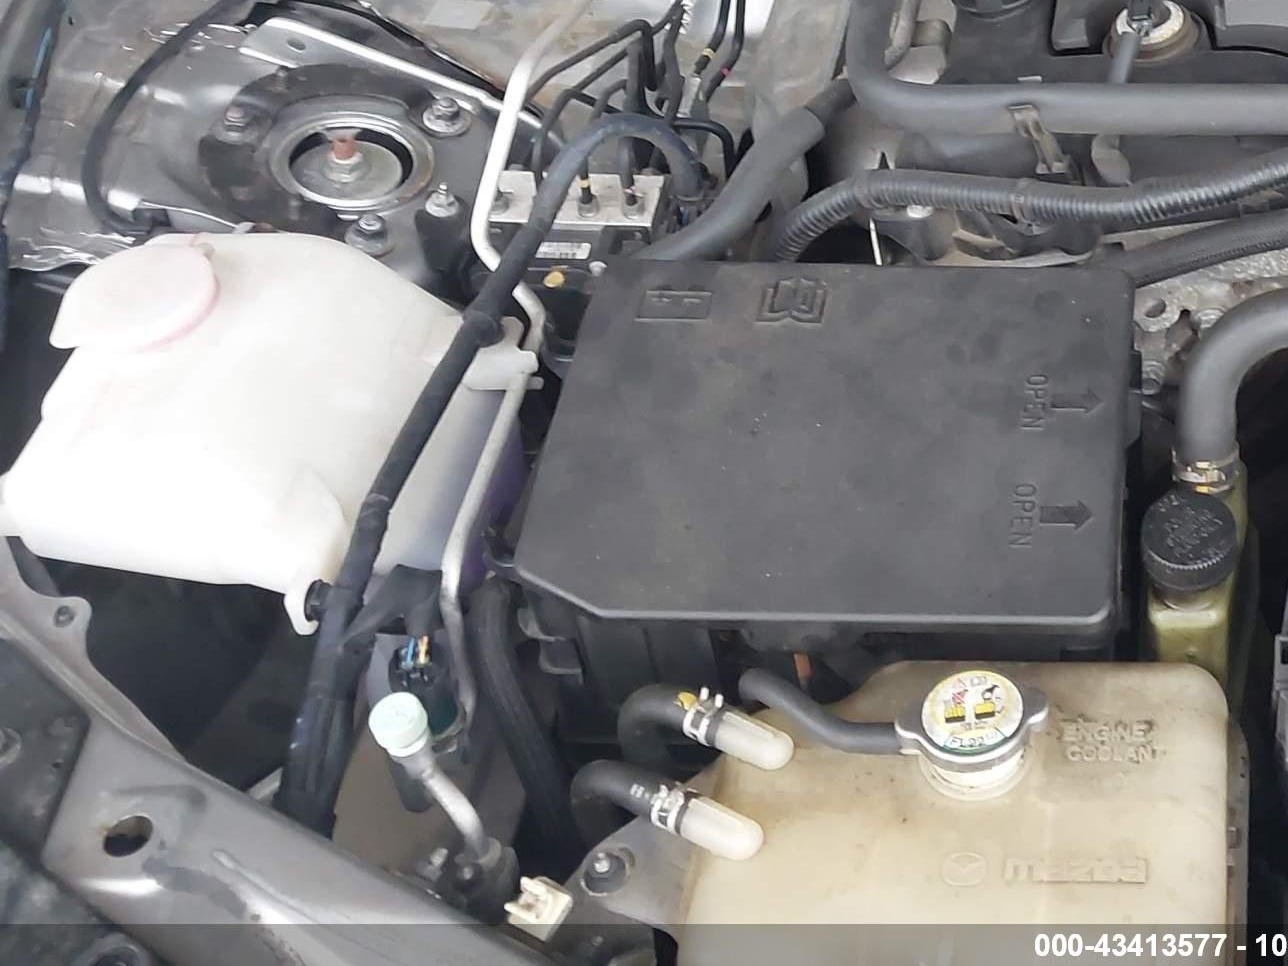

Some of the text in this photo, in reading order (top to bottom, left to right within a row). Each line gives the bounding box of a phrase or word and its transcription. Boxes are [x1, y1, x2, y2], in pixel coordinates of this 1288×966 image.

[1020, 374, 1049, 431] OPEN
[1008, 483, 1037, 548] OPEN
[1060, 720, 1148, 742] ENGINE
[1065, 745, 1166, 763] COOLANT
